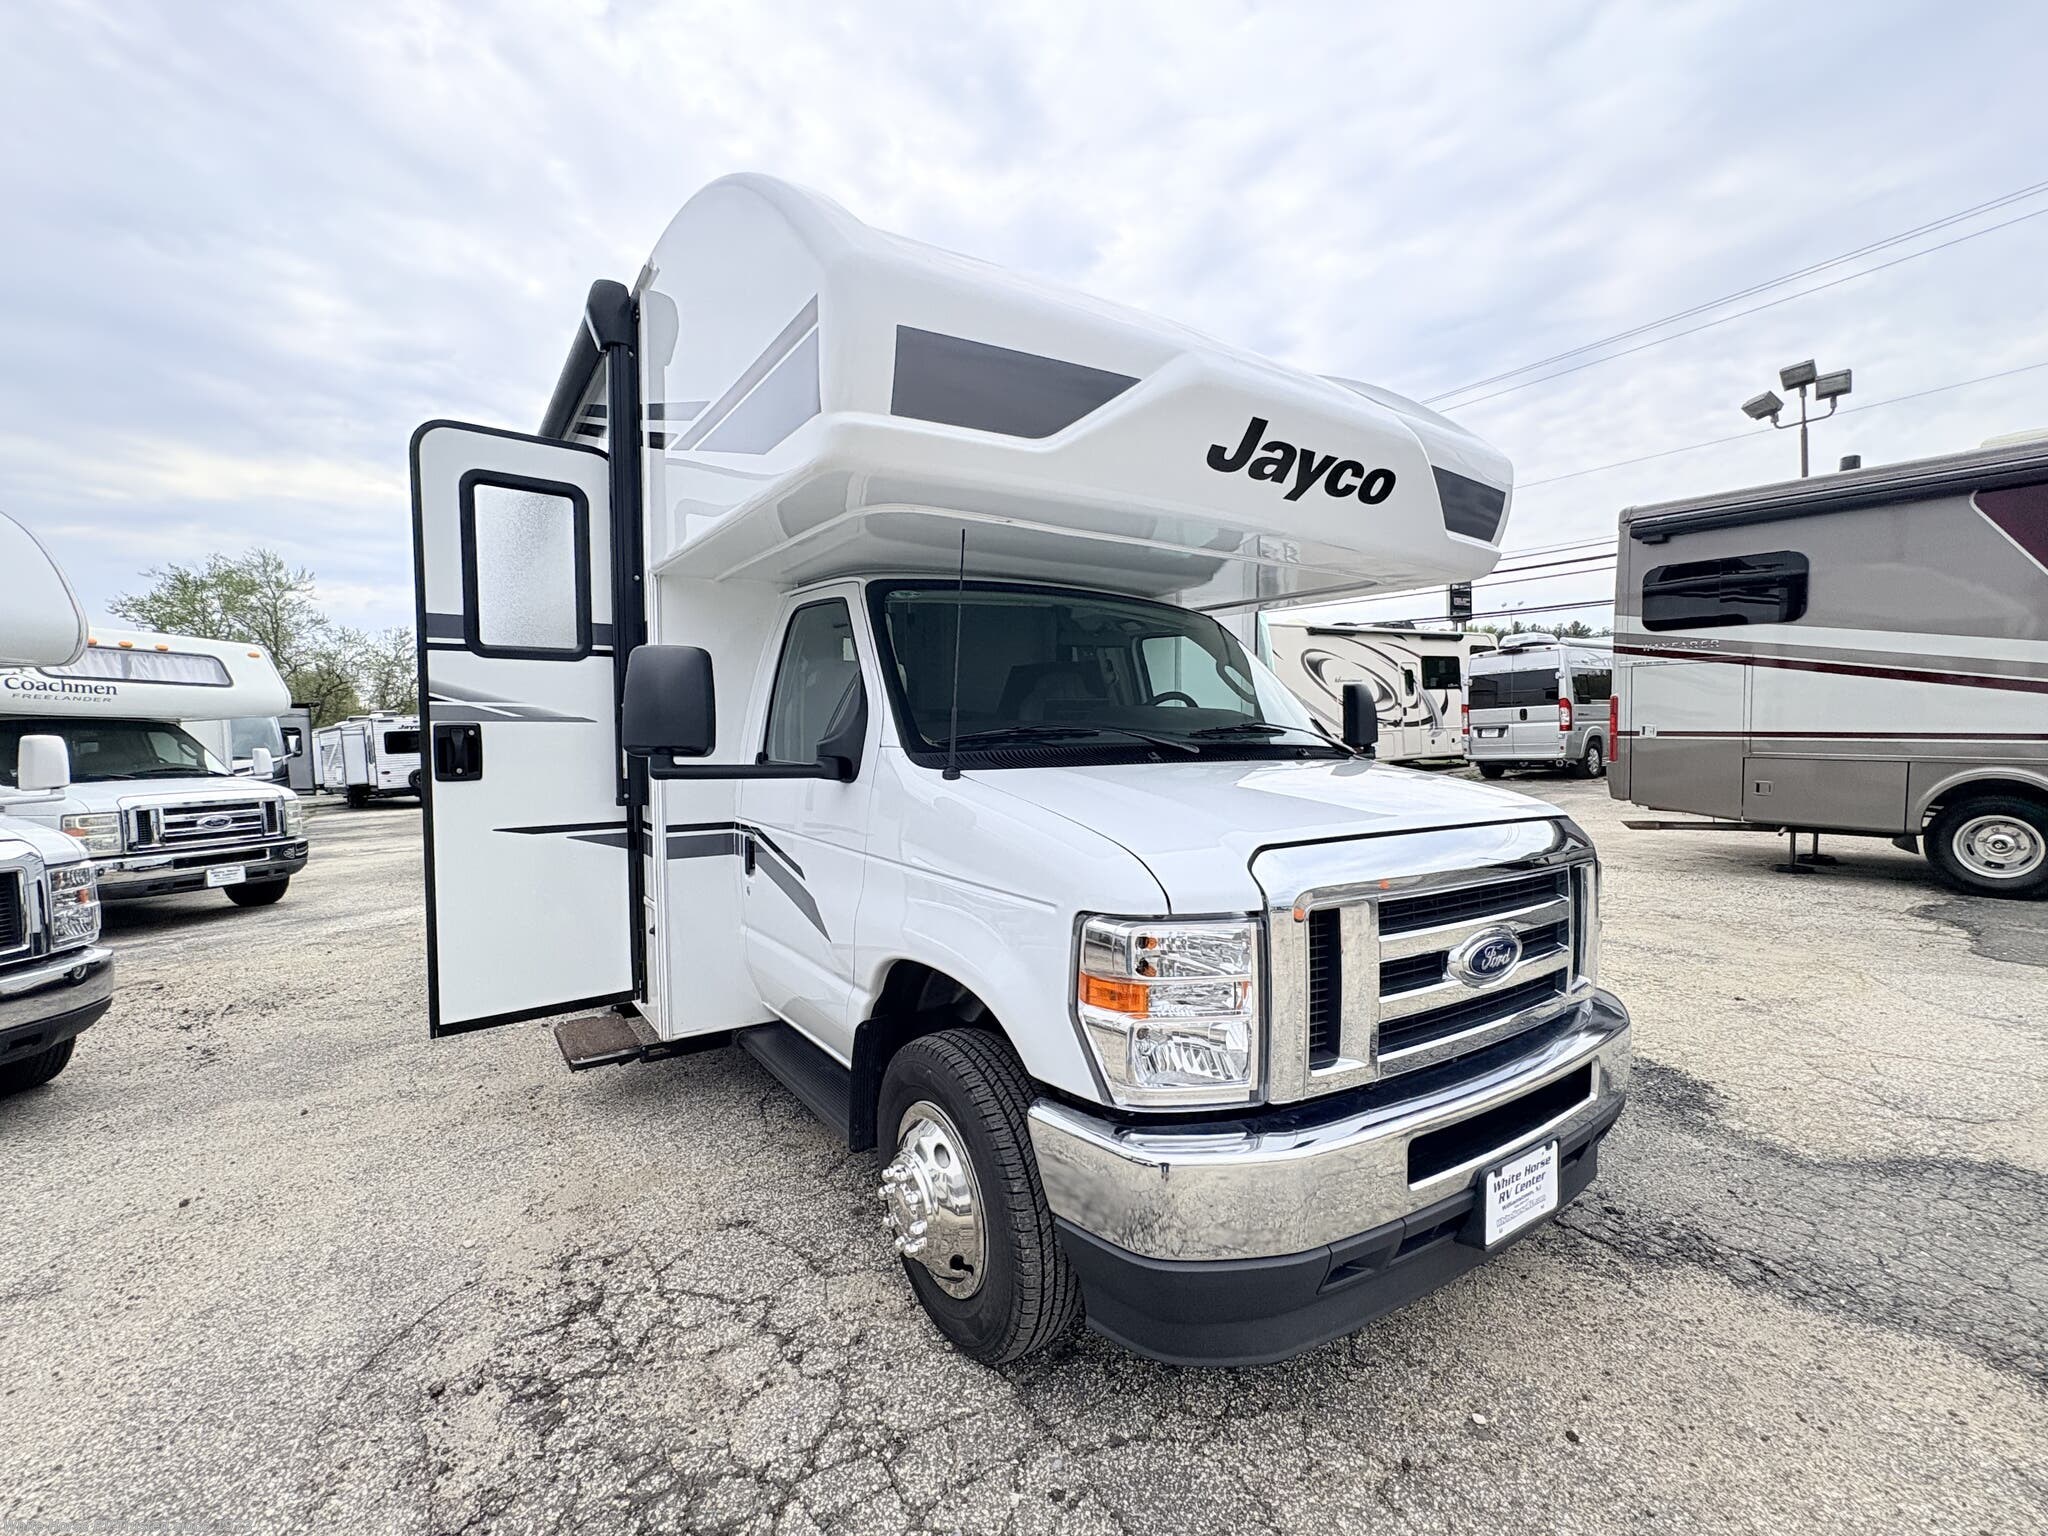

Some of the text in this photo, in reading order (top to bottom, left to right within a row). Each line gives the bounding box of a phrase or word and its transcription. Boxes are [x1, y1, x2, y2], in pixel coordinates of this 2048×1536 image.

[1206, 416, 1397, 505] Jayco
[4, 677, 118, 696] Coachmen
[12, 693, 112, 703] FREELANDER
[1482, 943, 1511, 971] Ford
[1493, 1156, 1551, 1193] White Horse
[1498, 1187, 1513, 1205] RV
[1515, 1171, 1546, 1195] Center
